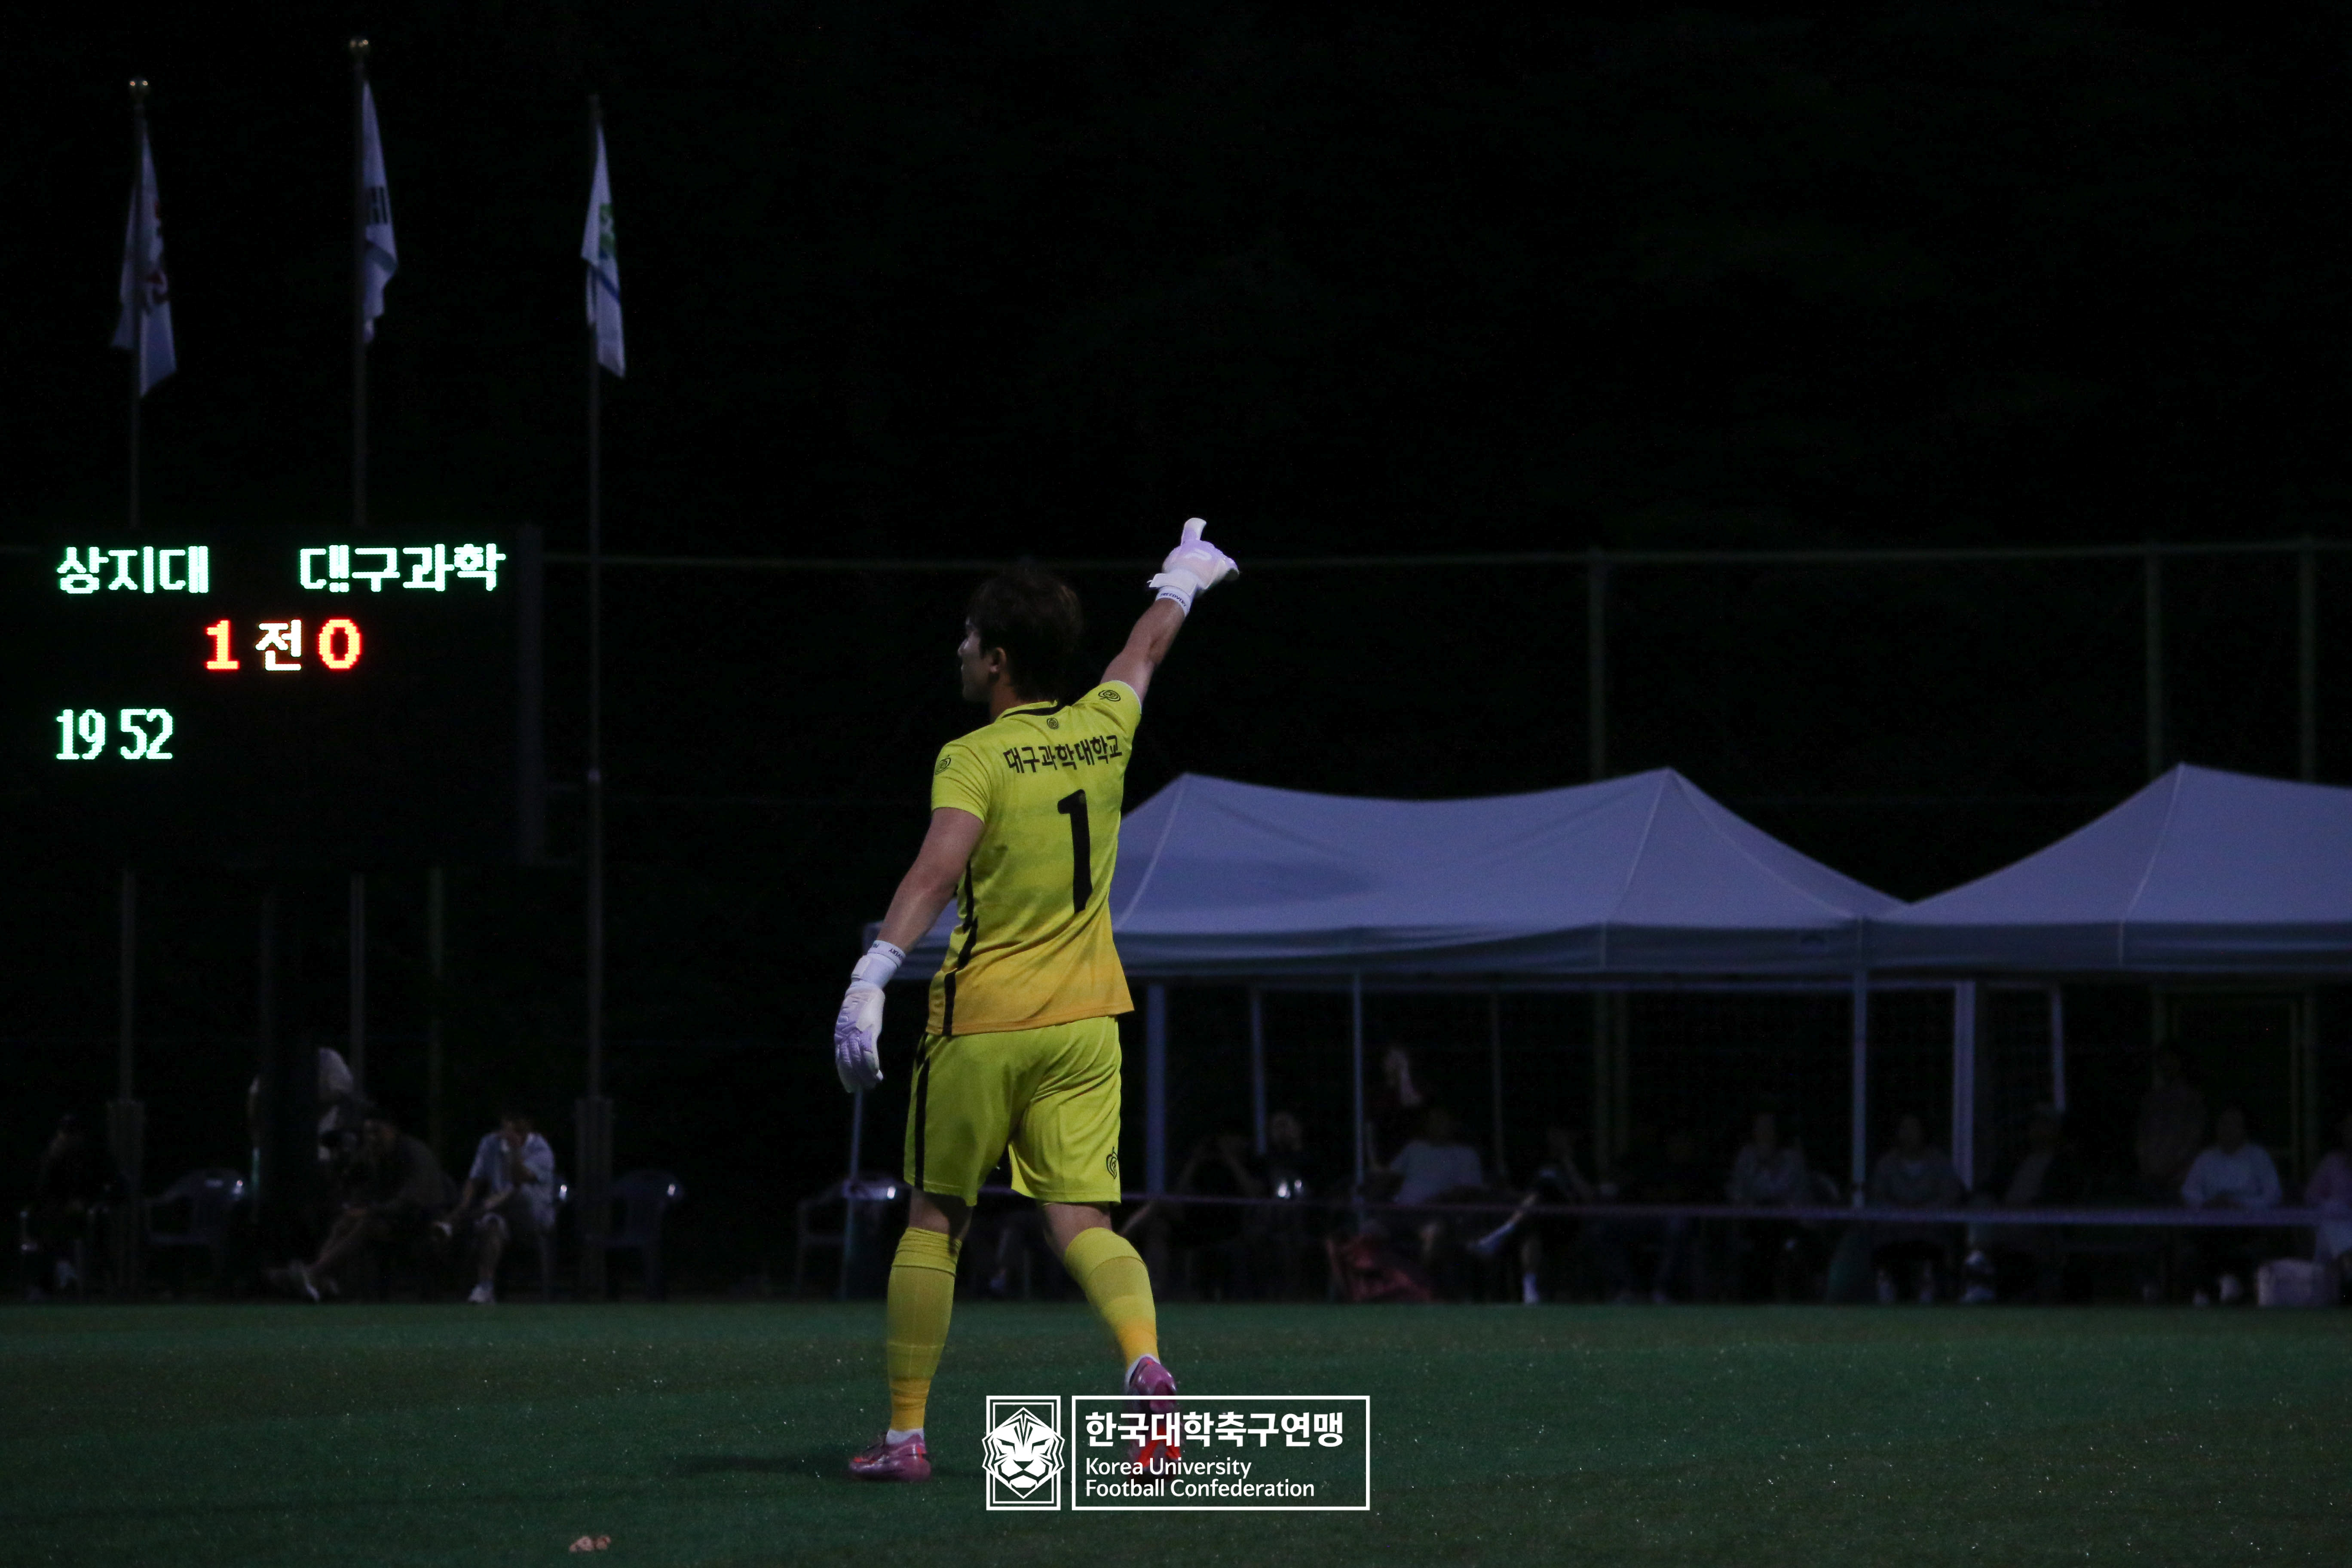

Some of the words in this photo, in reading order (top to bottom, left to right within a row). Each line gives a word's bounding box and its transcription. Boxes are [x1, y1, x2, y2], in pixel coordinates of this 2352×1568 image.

[56, 545, 209, 594] 상지대
[300, 543, 506, 593] 대구과학
[205, 619, 240, 671] 1
[255, 619, 302, 671] 전
[316, 618, 362, 671] 0
[56, 709, 106, 760] 19
[120, 708, 173, 760] 52
[1003, 735, 1122, 773] 대구과학대학교
[1057, 789, 1093, 913] 1
